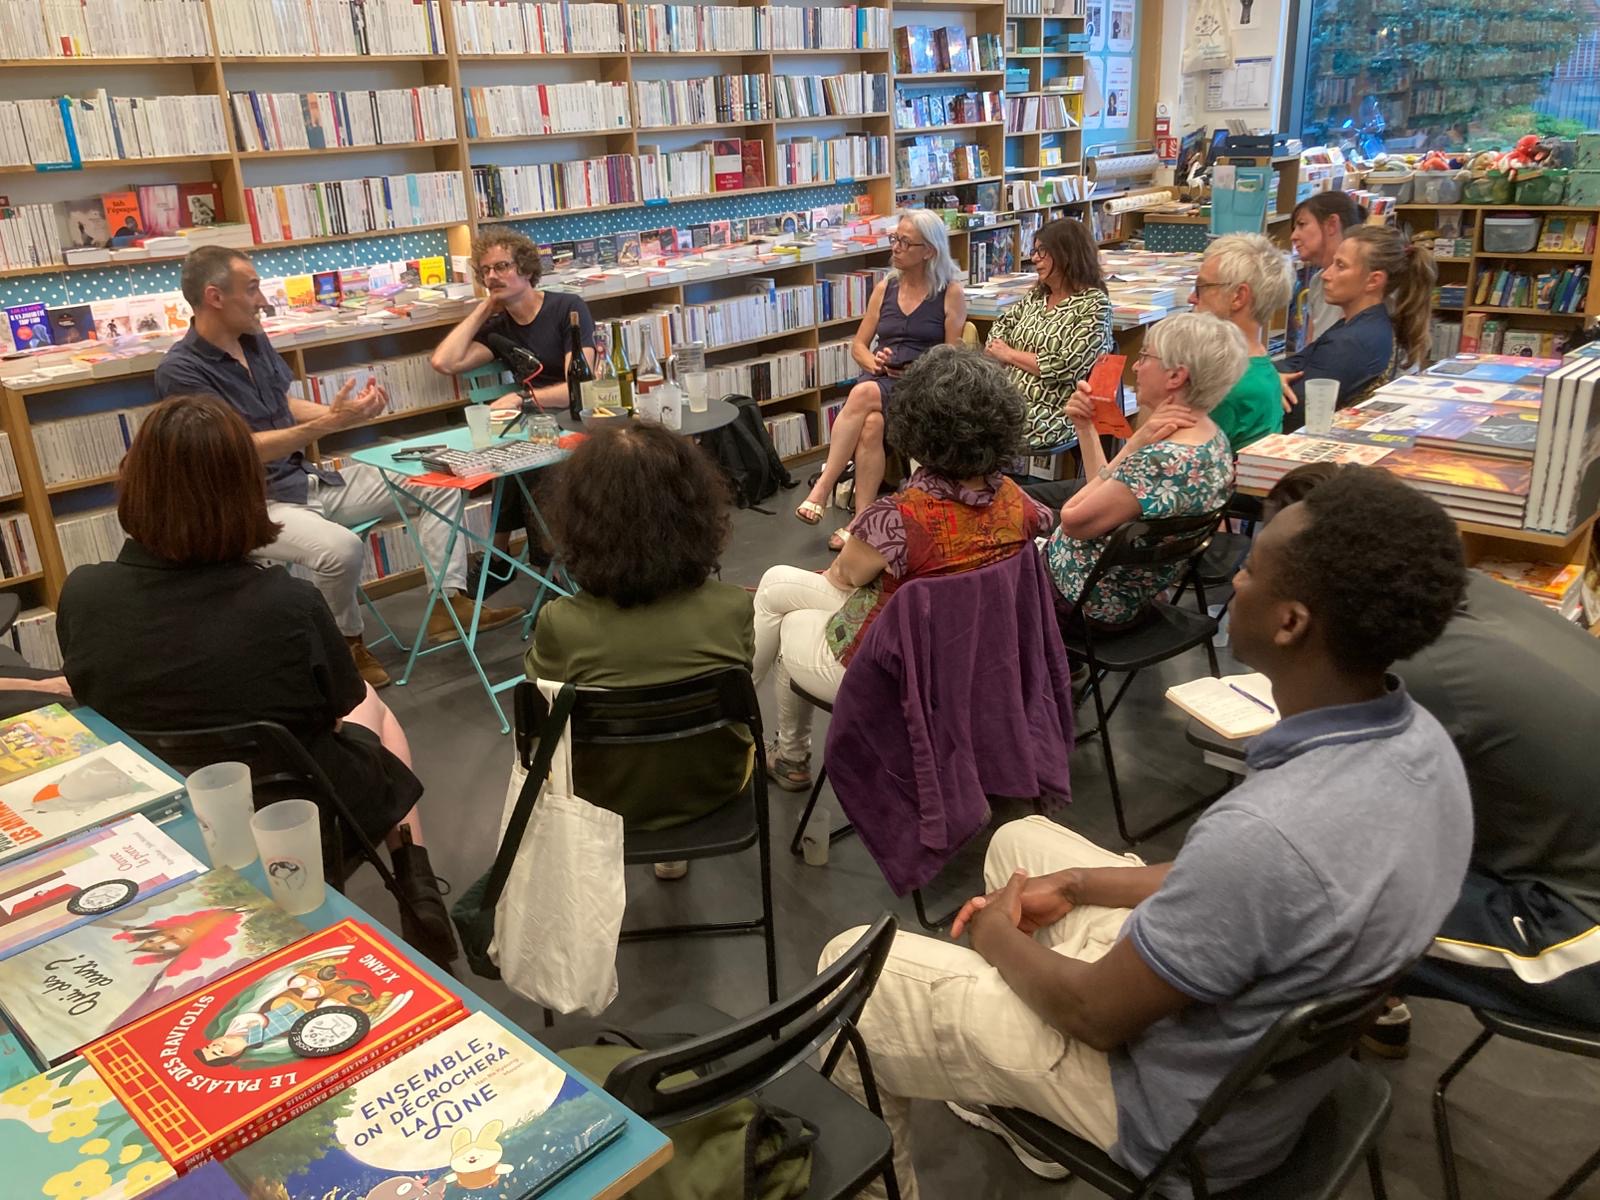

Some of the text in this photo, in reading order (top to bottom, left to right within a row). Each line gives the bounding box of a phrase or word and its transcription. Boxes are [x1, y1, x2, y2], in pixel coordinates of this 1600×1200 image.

[73, 960, 113, 989] deux
[358, 953, 391, 977] FANG
[41, 975, 101, 1016] Qui des
[159, 994, 297, 1094] LE PALAIS DES RAVIOLIS
[354, 1123, 383, 1146] ON
[389, 1047, 510, 1125] DÉCROCHERA
[360, 1038, 493, 1120] ENSEMBLE,
[401, 1083, 498, 1140] LA LUNE
